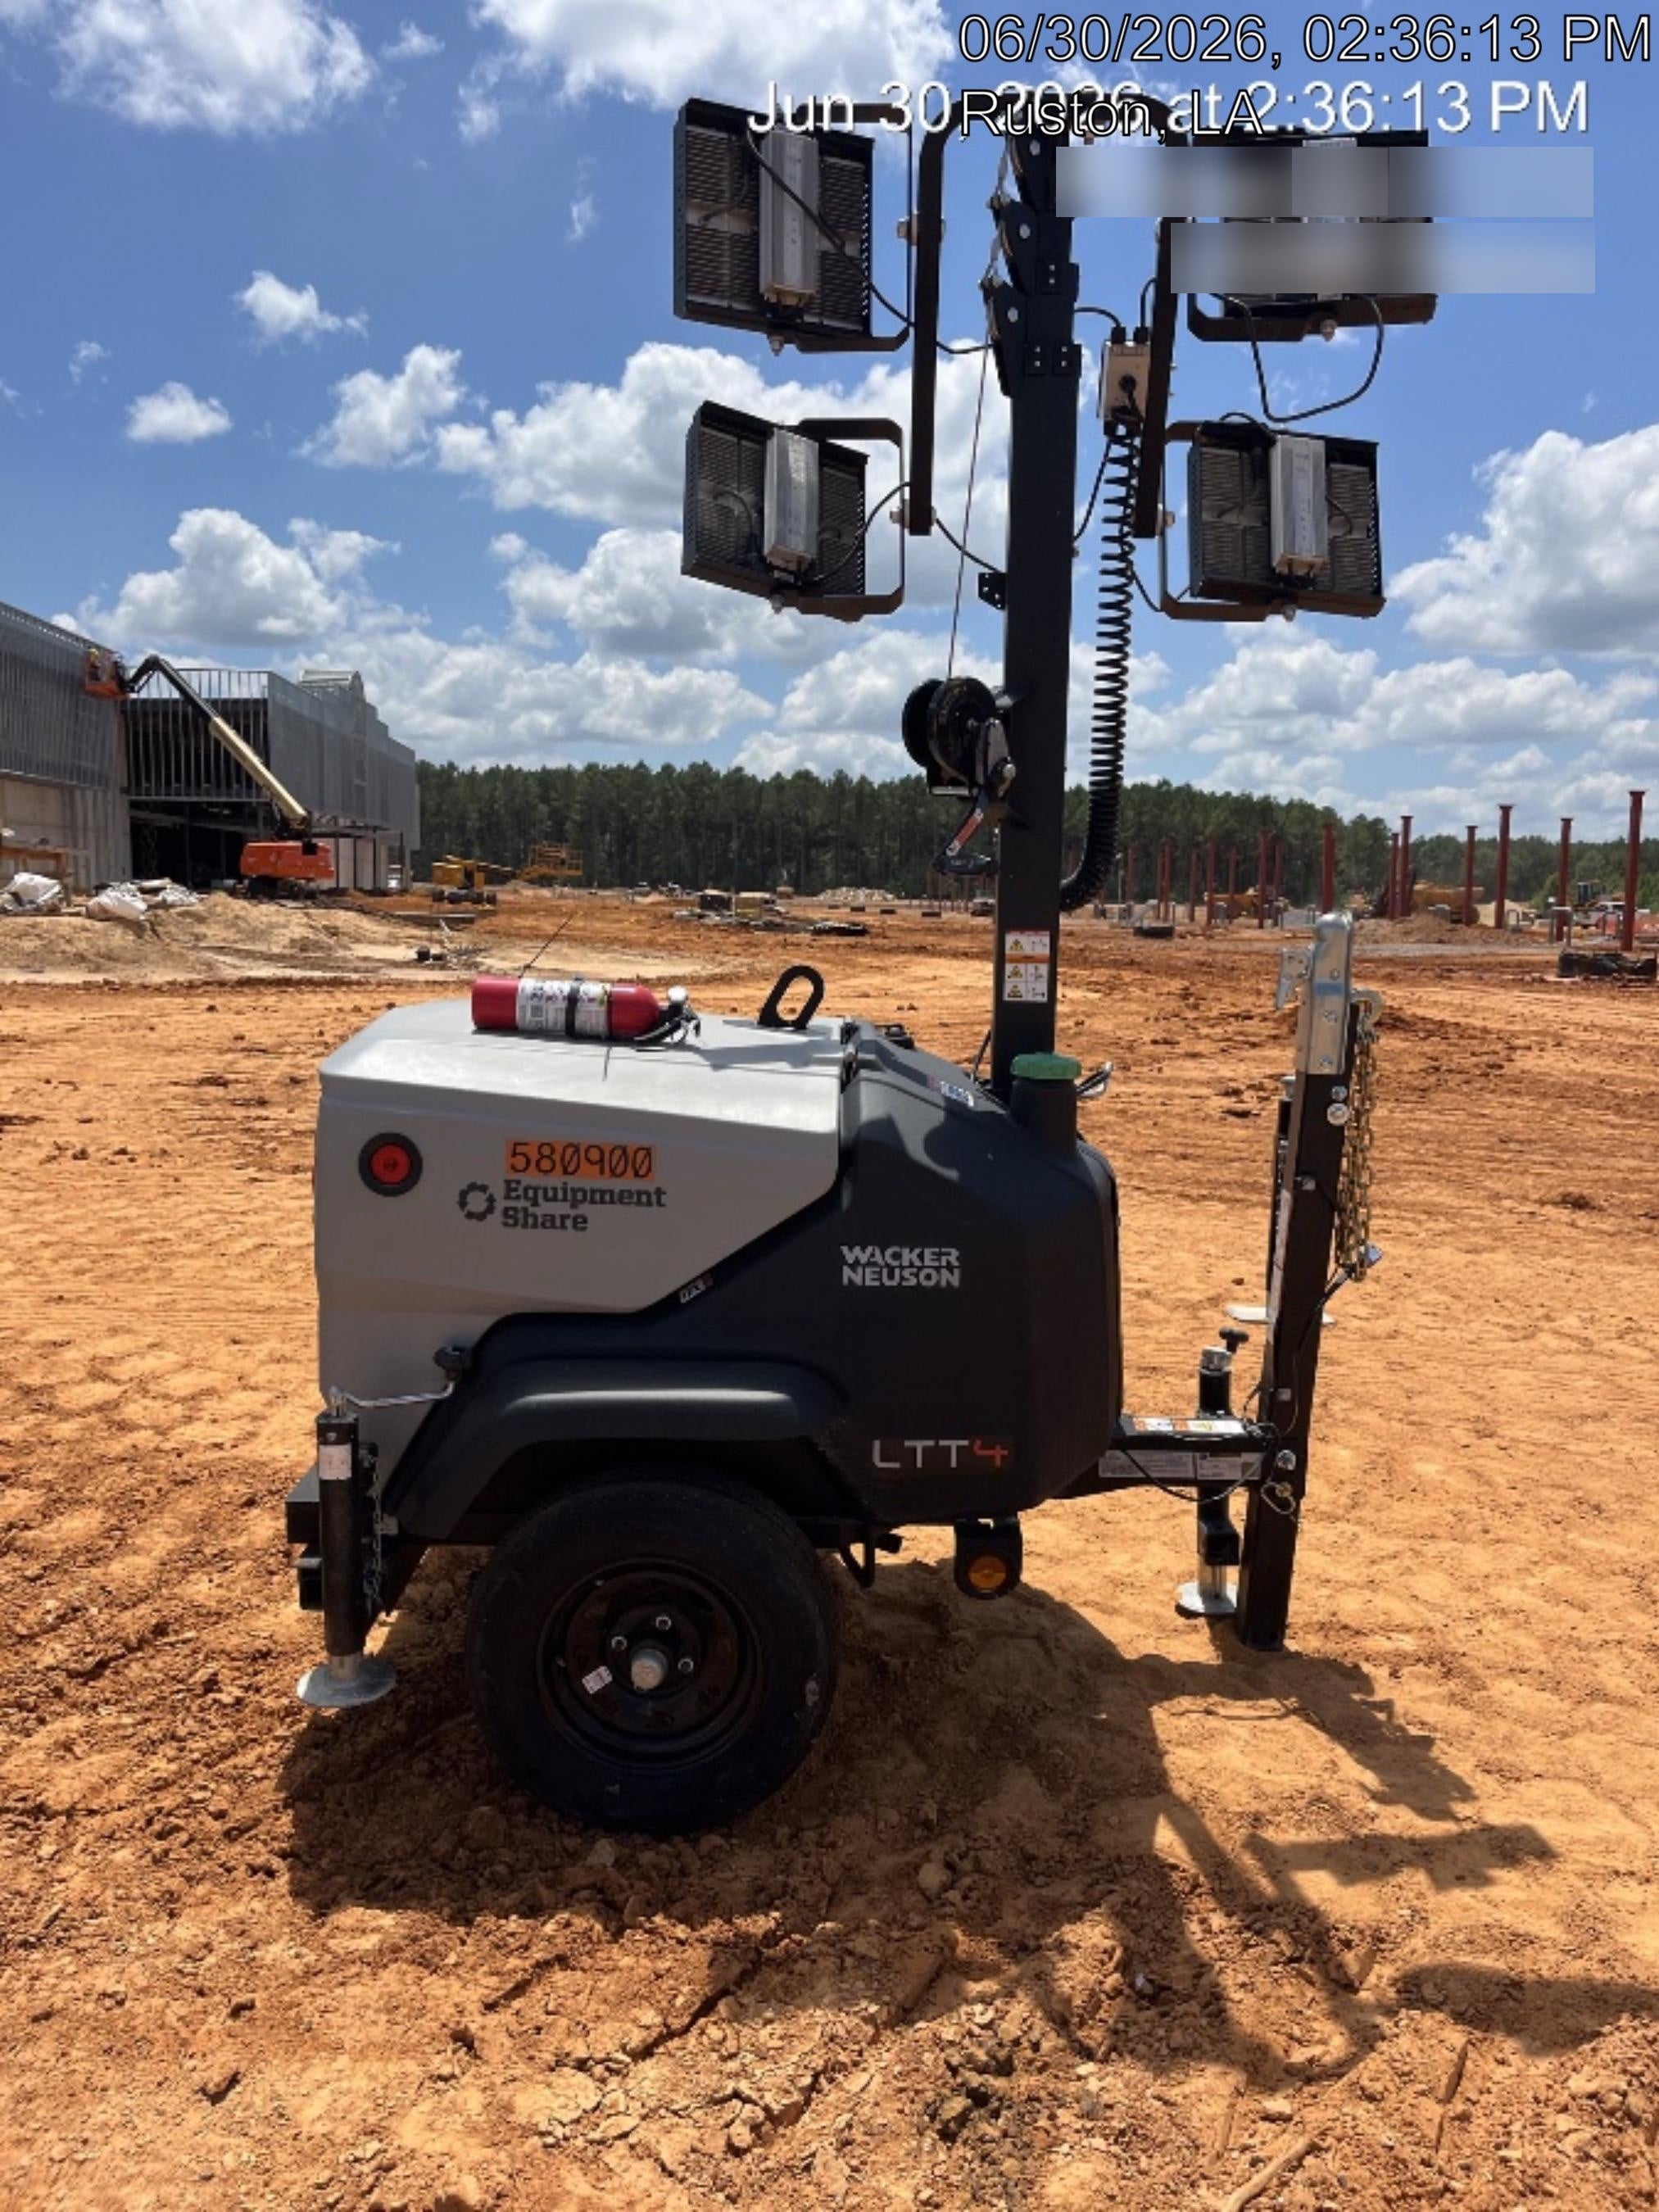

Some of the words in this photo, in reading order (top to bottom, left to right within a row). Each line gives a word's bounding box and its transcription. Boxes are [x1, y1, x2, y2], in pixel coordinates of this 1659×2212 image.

[510, 1141, 652, 1178] 580900
[502, 1179, 668, 1209] Equipment
[501, 1206, 589, 1232] Share
[841, 1244, 961, 1267] WACKER
[841, 1265, 961, 1288] NEUSON
[872, 1439, 1009, 1469] LTT4
